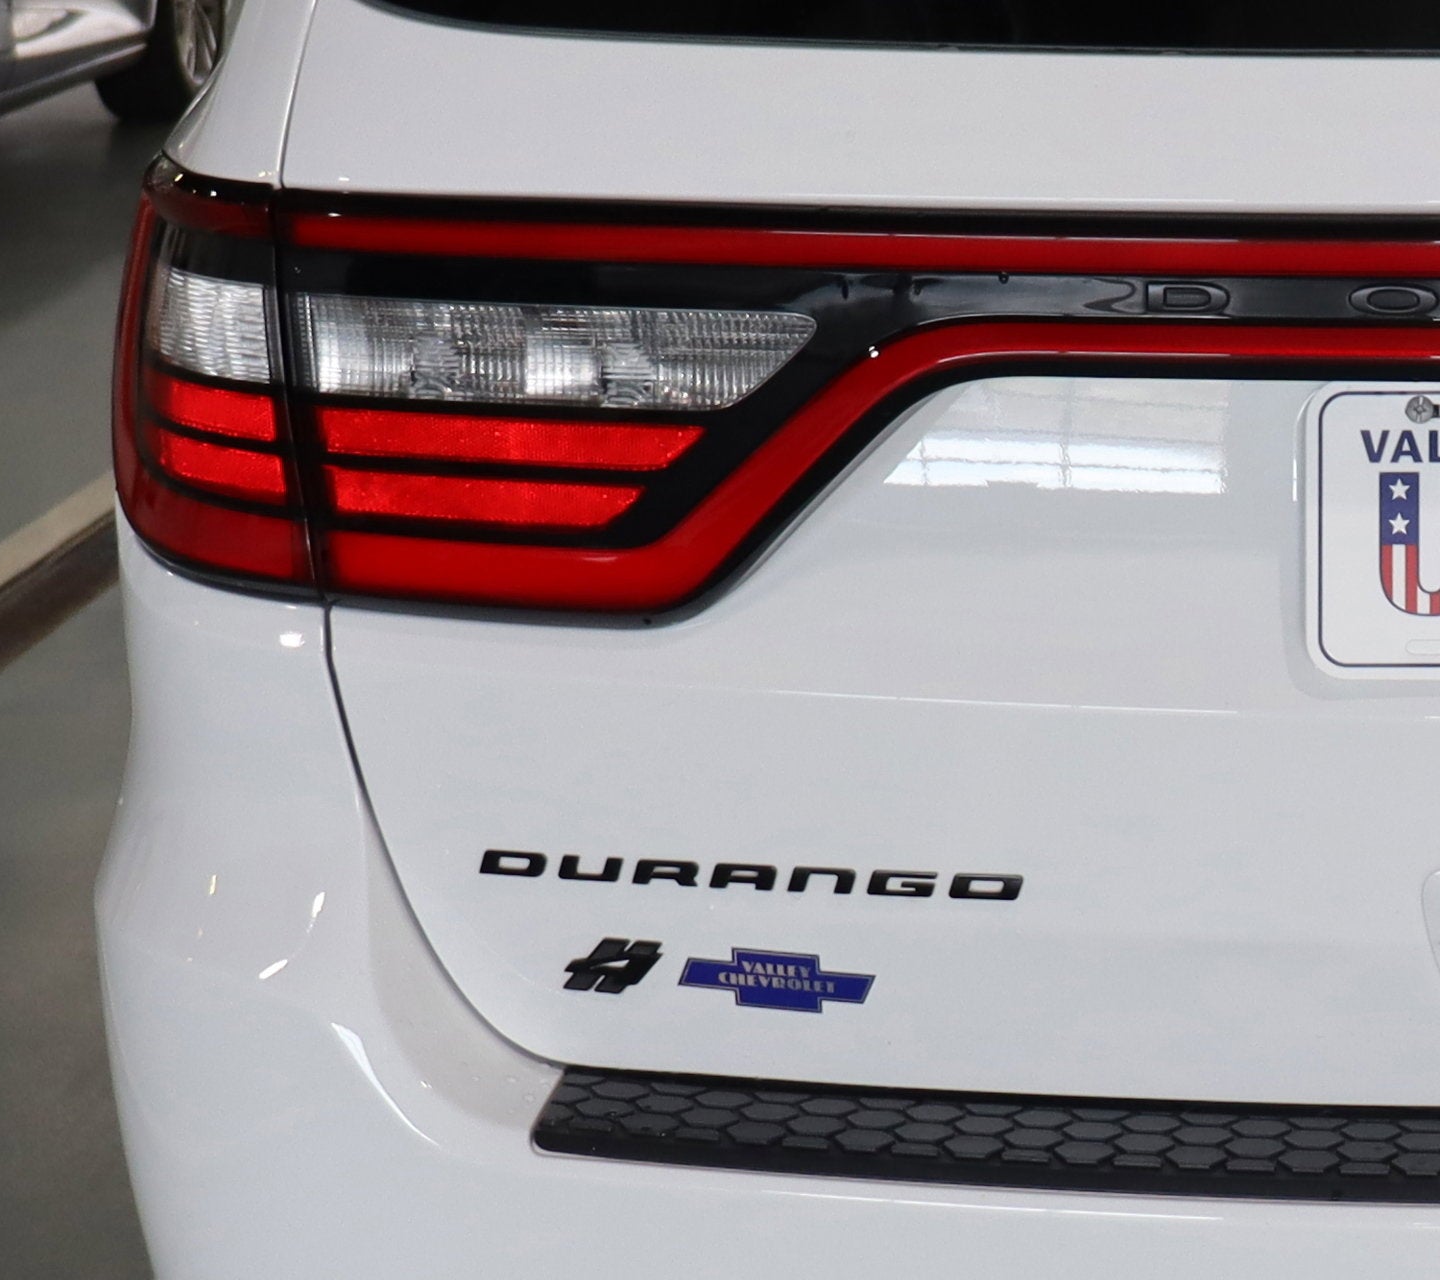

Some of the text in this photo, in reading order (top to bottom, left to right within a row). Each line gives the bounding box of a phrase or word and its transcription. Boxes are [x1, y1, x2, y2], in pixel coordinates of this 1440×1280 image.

[478, 848, 1025, 902] DURANGO
[741, 960, 810, 978] VALLEY
[717, 971, 836, 994] CHEVROLET
